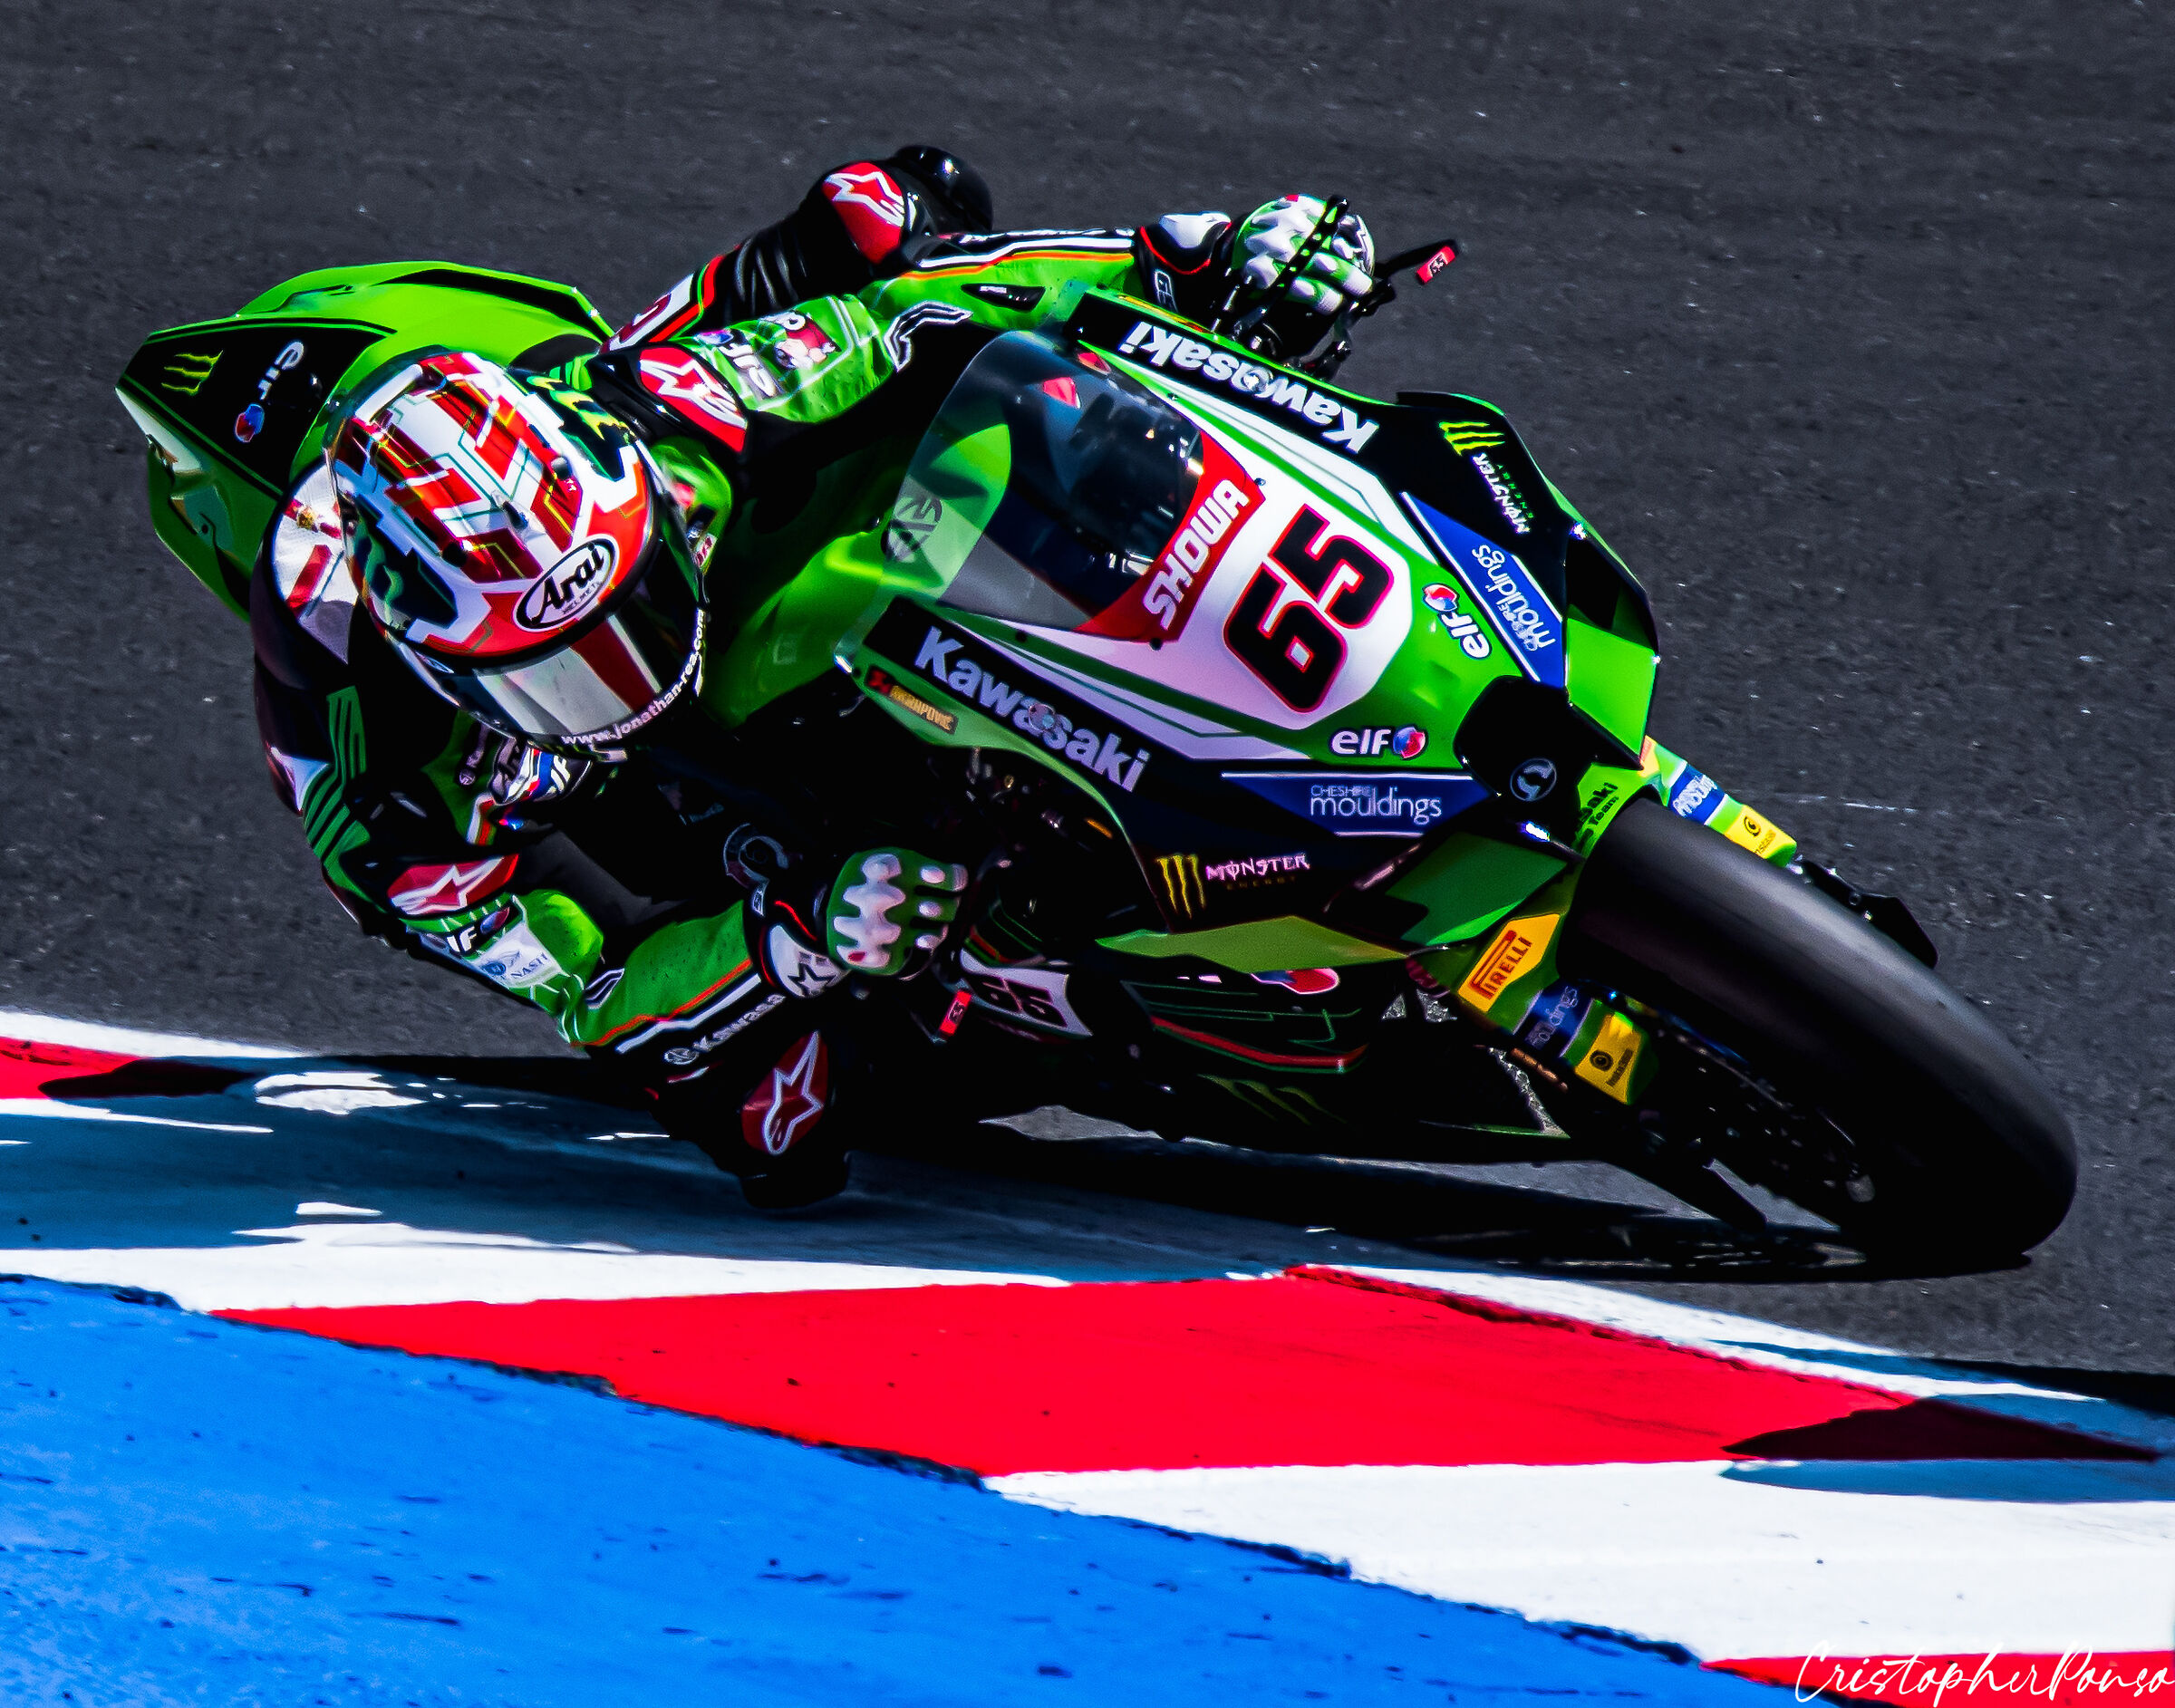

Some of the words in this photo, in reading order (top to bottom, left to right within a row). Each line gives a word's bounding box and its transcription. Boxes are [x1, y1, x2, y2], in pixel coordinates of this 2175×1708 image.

[1119, 321, 1380, 454] Kawasaki
[1471, 452, 1531, 534] MONSTER
[531, 542, 604, 624] Arai
[1142, 478, 1252, 631] SHOWA
[1471, 544, 1557, 650] mouldings
[1223, 503, 1395, 714] 65
[914, 625, 1151, 793] Kawasaki
[1310, 786, 1443, 825] mouldings
[1204, 853, 1311, 882] MONSTER
[1469, 930, 1533, 1000] PIRELLI
